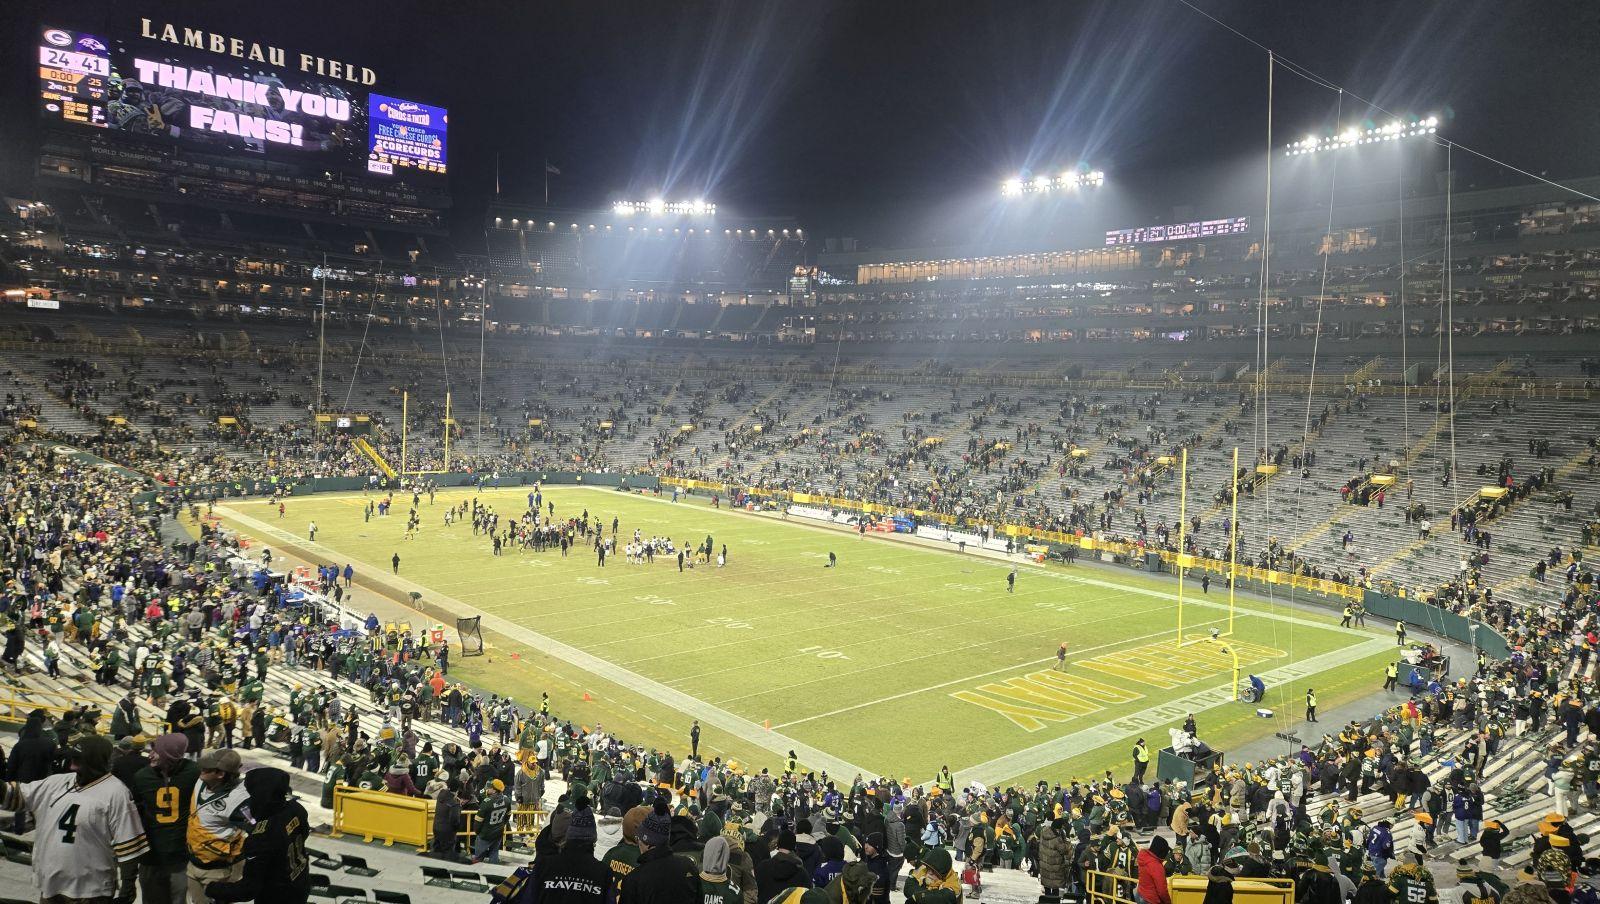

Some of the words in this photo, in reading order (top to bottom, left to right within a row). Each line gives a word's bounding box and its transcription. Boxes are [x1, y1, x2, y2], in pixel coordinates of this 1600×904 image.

[48, 50, 69, 66] 24
[141, 17, 286, 67] LAMBEAU
[300, 53, 377, 86] FIELD
[82, 57, 102, 73] 41
[51, 71, 73, 81] 0:00
[134, 58, 270, 107] THANK
[278, 87, 350, 121] YOU
[190, 105, 304, 147] FANS!
[379, 123, 394, 137] FREE
[91, 146, 117, 156] WORLD
[119, 151, 162, 163] CHAMPIONS
[376, 140, 441, 159] SCORECURDS
[1168, 225, 1186, 236] 0:00
[798, 645, 844, 659] 10
[416, 764, 428, 777] 10
[156, 786, 181, 824] 9
[58, 803, 81, 844] 4
[489, 808, 507, 825] 87
[543, 880, 602, 895] RAVENS
[1407, 886, 1426, 903] 52
